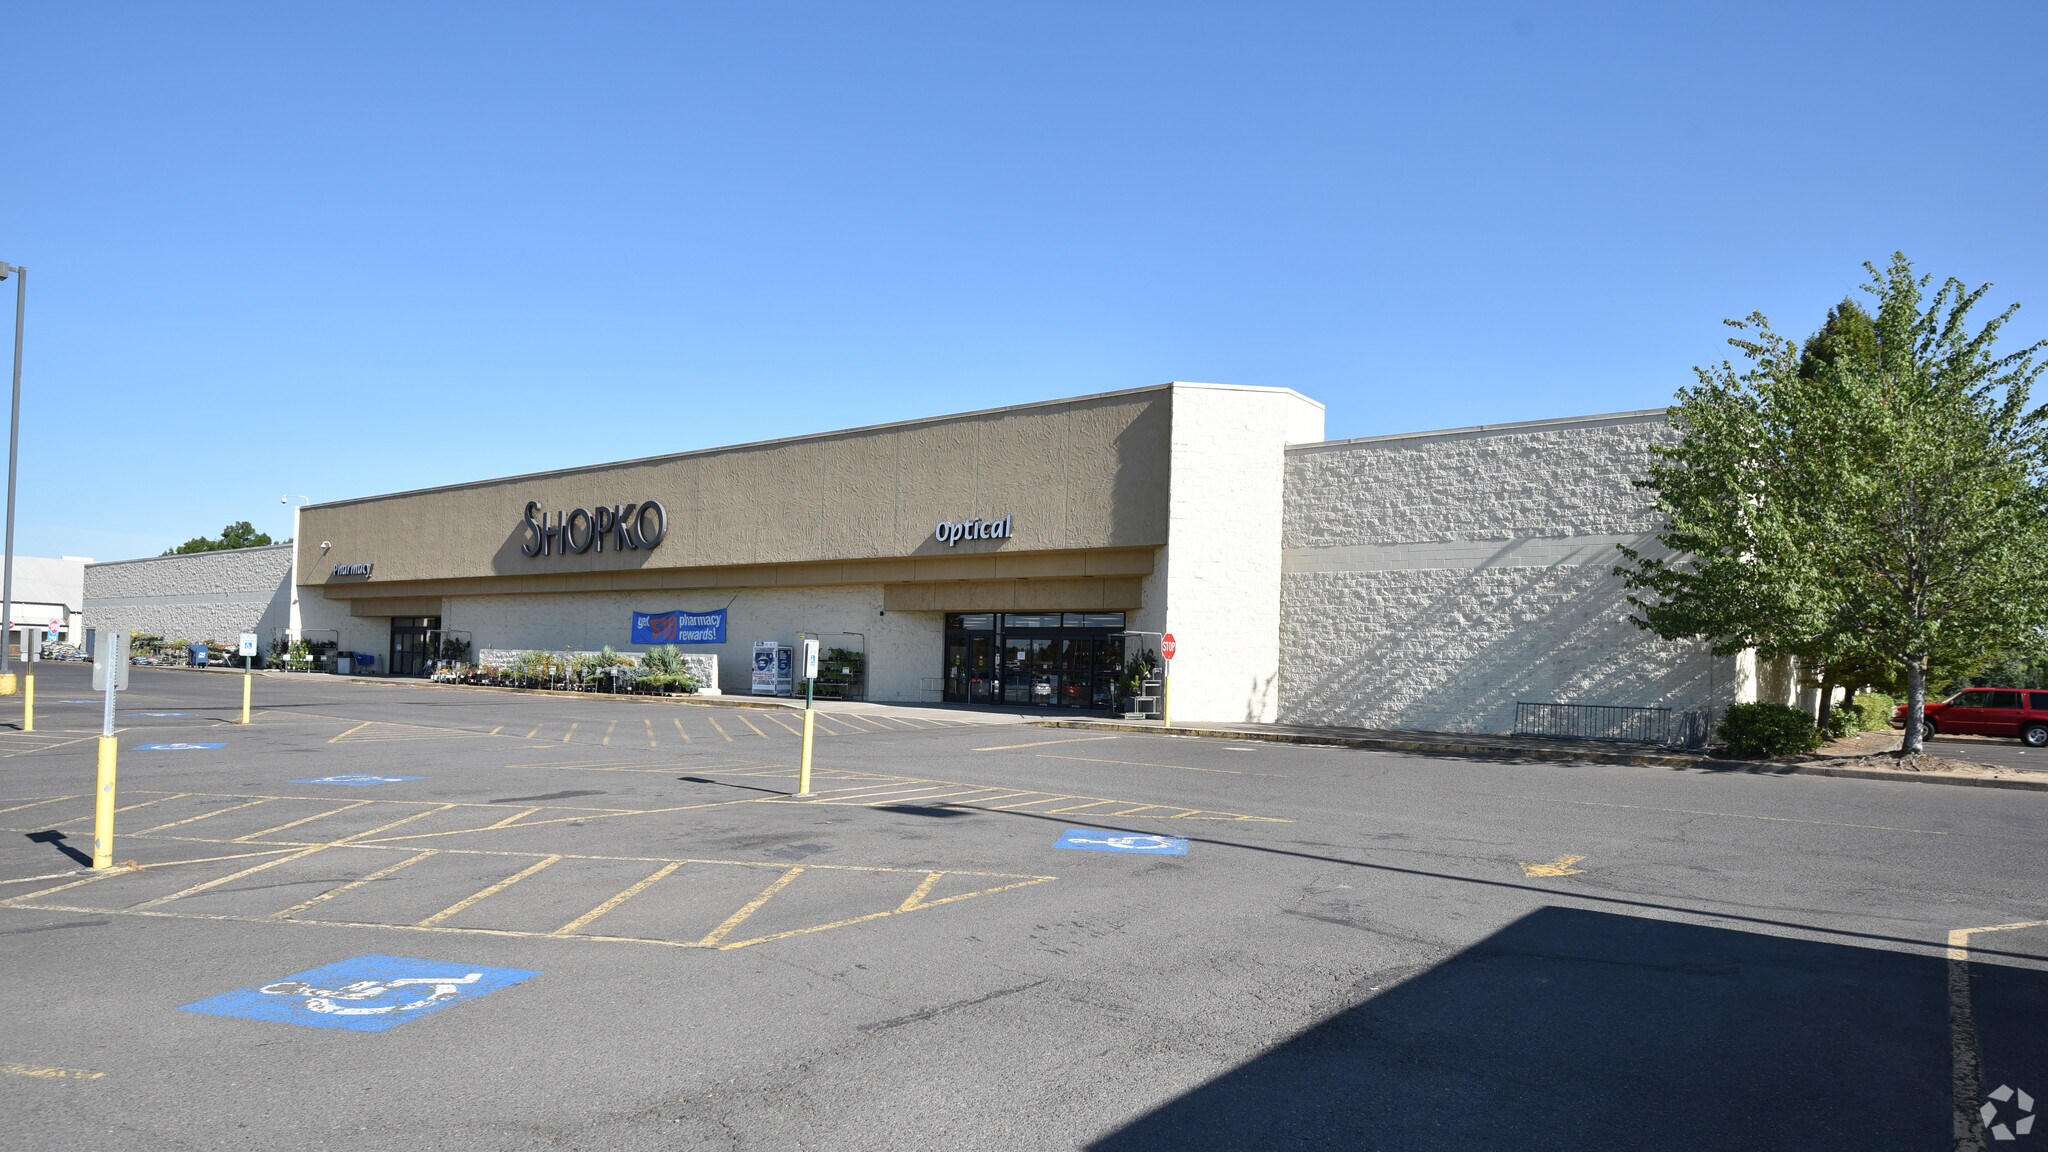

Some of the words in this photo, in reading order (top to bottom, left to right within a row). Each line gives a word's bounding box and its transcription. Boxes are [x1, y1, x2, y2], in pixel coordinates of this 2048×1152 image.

[521, 500, 667, 558] SHOPKO
[935, 514, 1011, 547] Optical
[333, 563, 371, 578] Pharmacy
[637, 616, 650, 629] get
[650, 615, 677, 640] $10
[679, 614, 721, 628] pharmacy
[679, 627, 716, 641] rewards!
[1162, 641, 1175, 652] STOP
